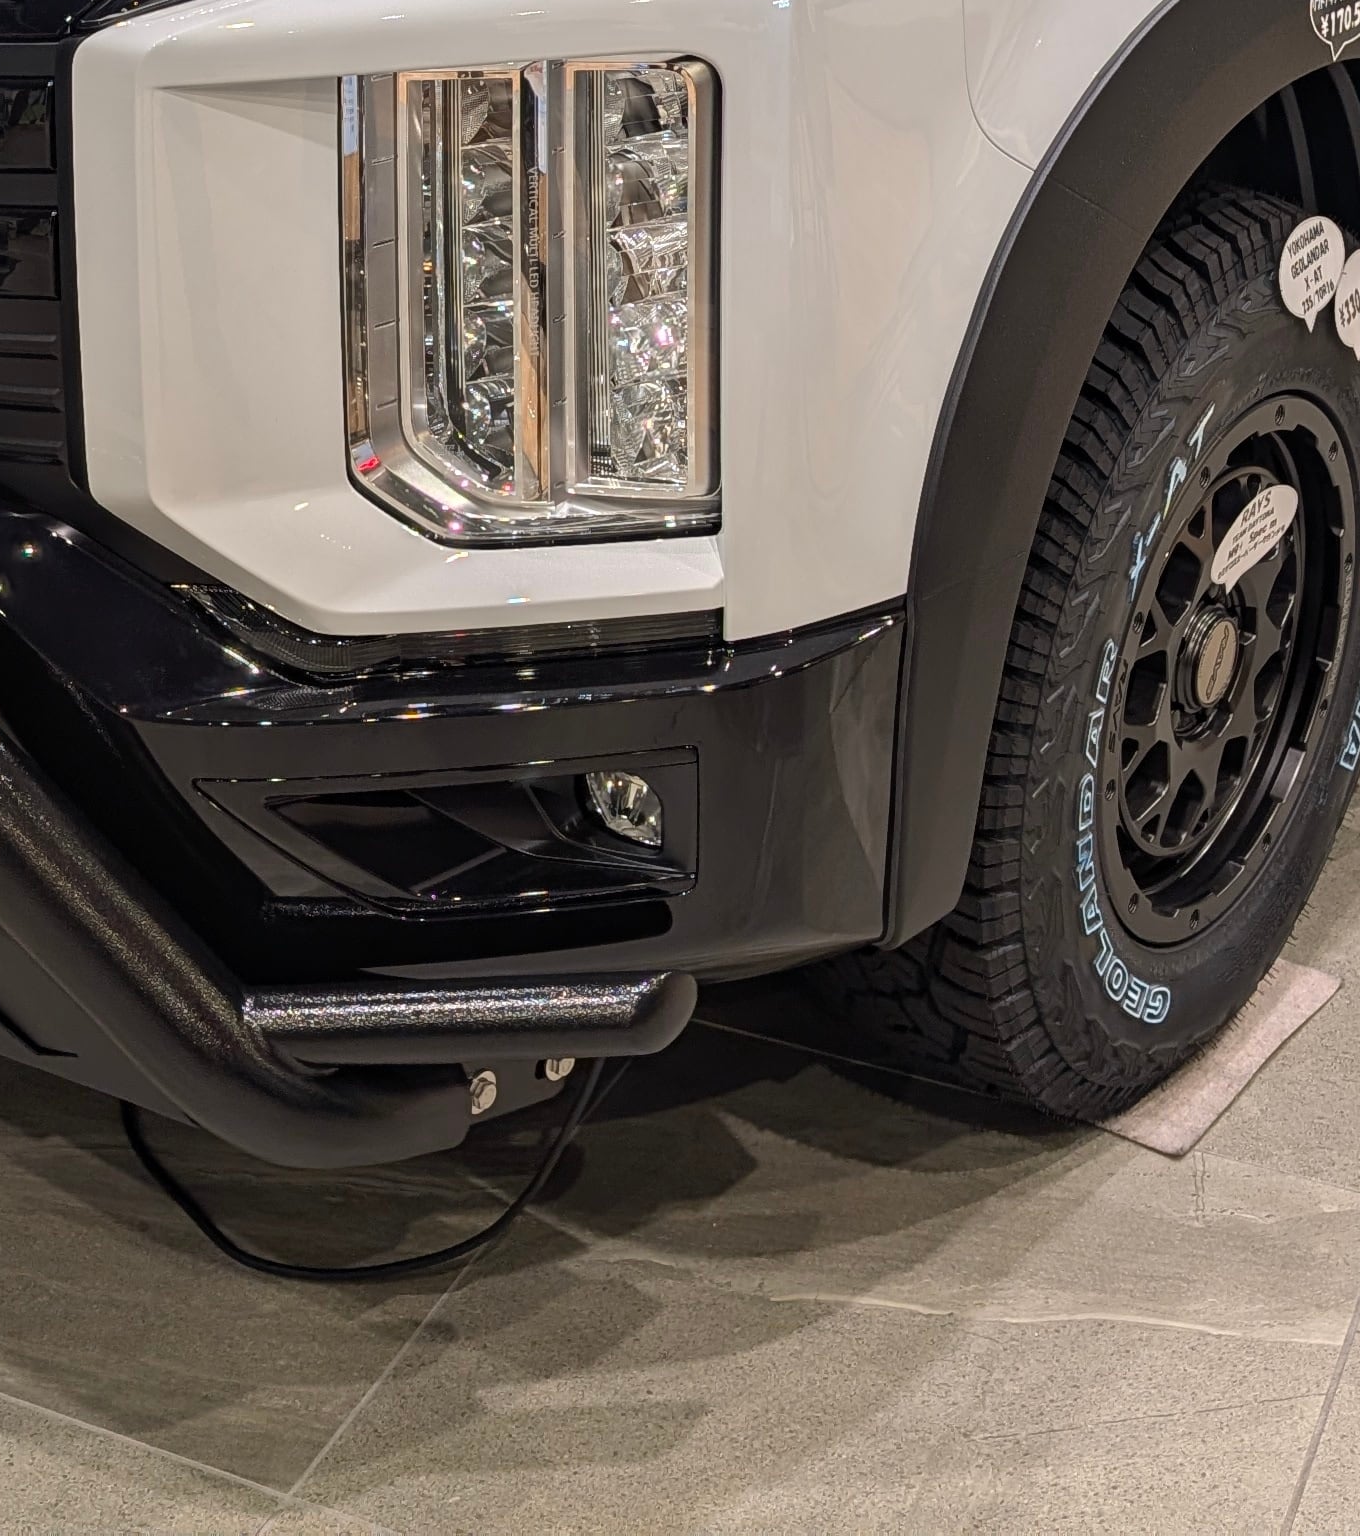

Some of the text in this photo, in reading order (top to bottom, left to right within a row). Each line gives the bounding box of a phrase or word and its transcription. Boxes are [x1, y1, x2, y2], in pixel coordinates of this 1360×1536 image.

[526, 166, 539, 224] VERTICAL
[1287, 221, 1325, 259] YOKOHAMA
[529, 266, 539, 289] LED
[1290, 239, 1329, 280] GEOLANDAR
[1304, 265, 1323, 292] X-AT
[1240, 490, 1272, 528] RAYS
[1074, 637, 1172, 1025] GEOLANDAR
